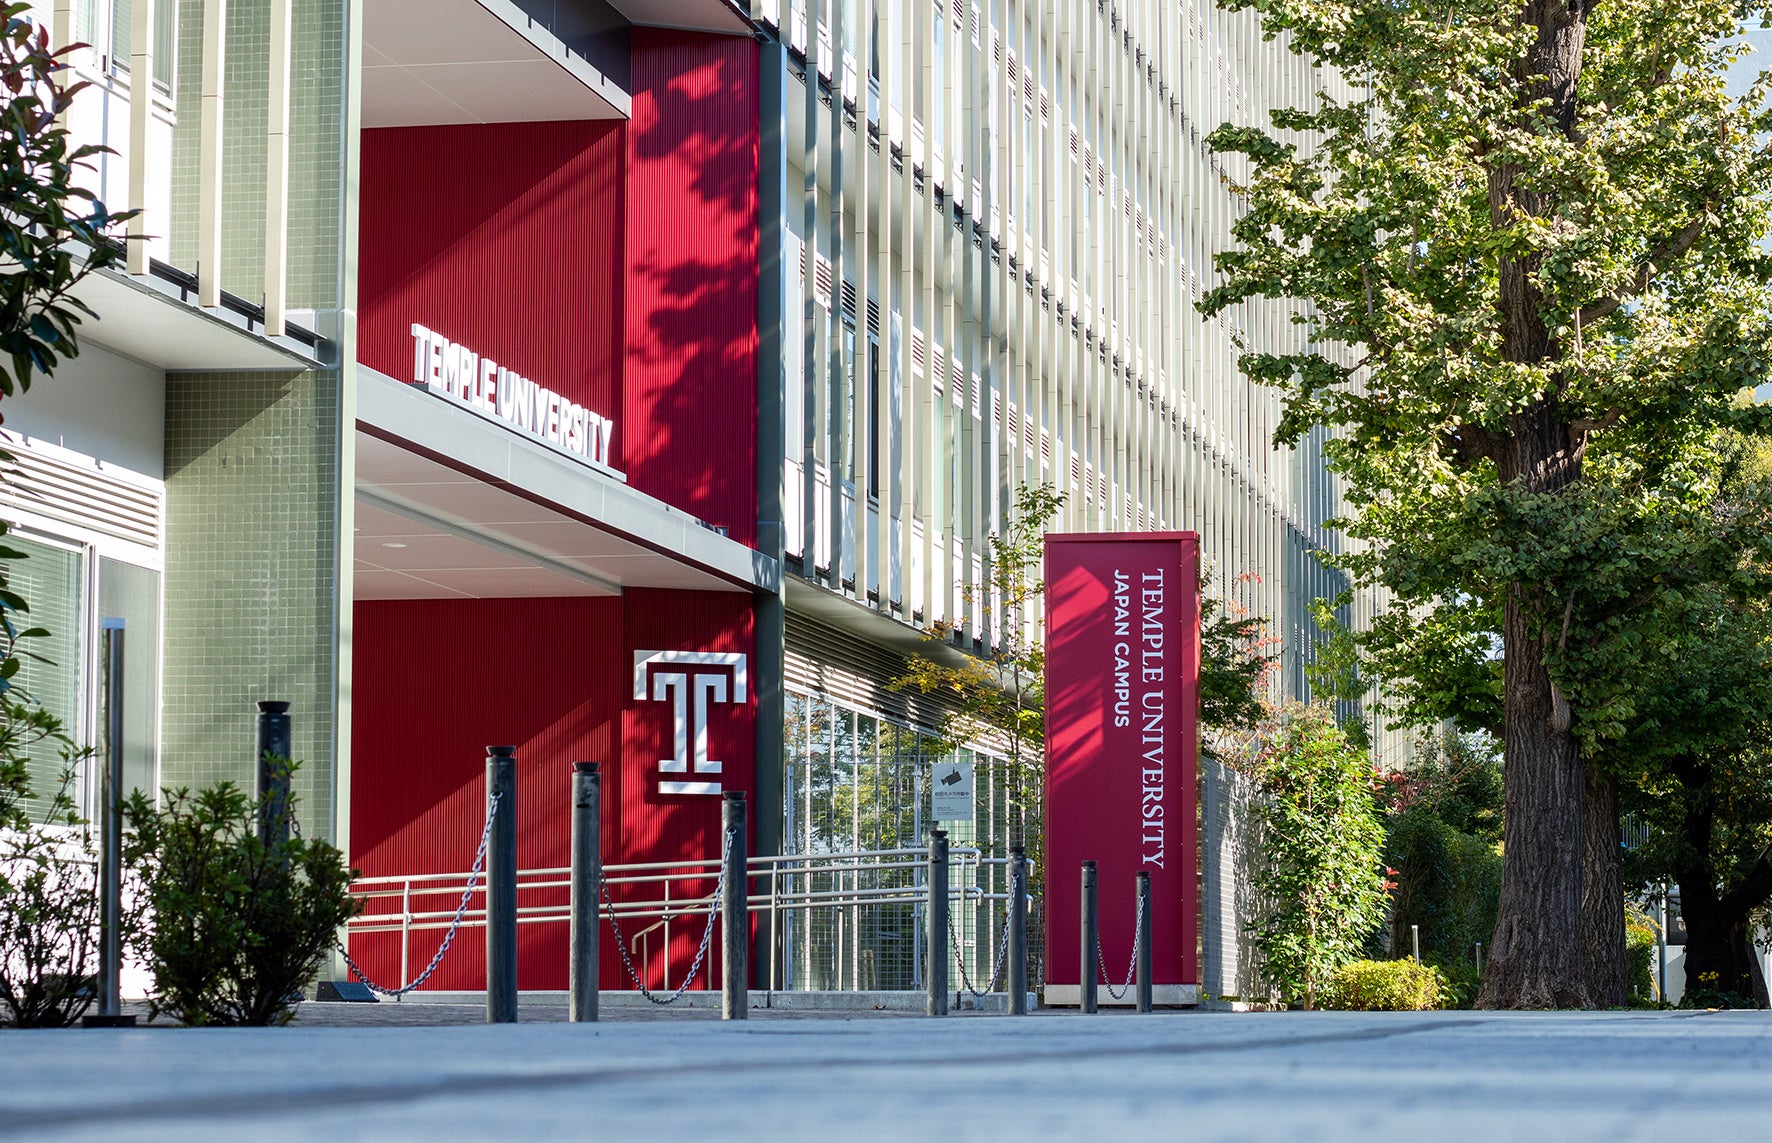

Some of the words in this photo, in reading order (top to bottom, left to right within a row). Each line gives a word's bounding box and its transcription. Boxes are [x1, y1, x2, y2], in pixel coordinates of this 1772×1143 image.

[411, 323, 497, 414] TEMPLE
[497, 367, 613, 466] UNIVERSITY
[1113, 569, 1130, 636] JAPAN
[1141, 568, 1164, 682] TEMPLE
[1113, 642, 1130, 727] CAMPUS
[1141, 690, 1164, 869] UNIVERSITY
